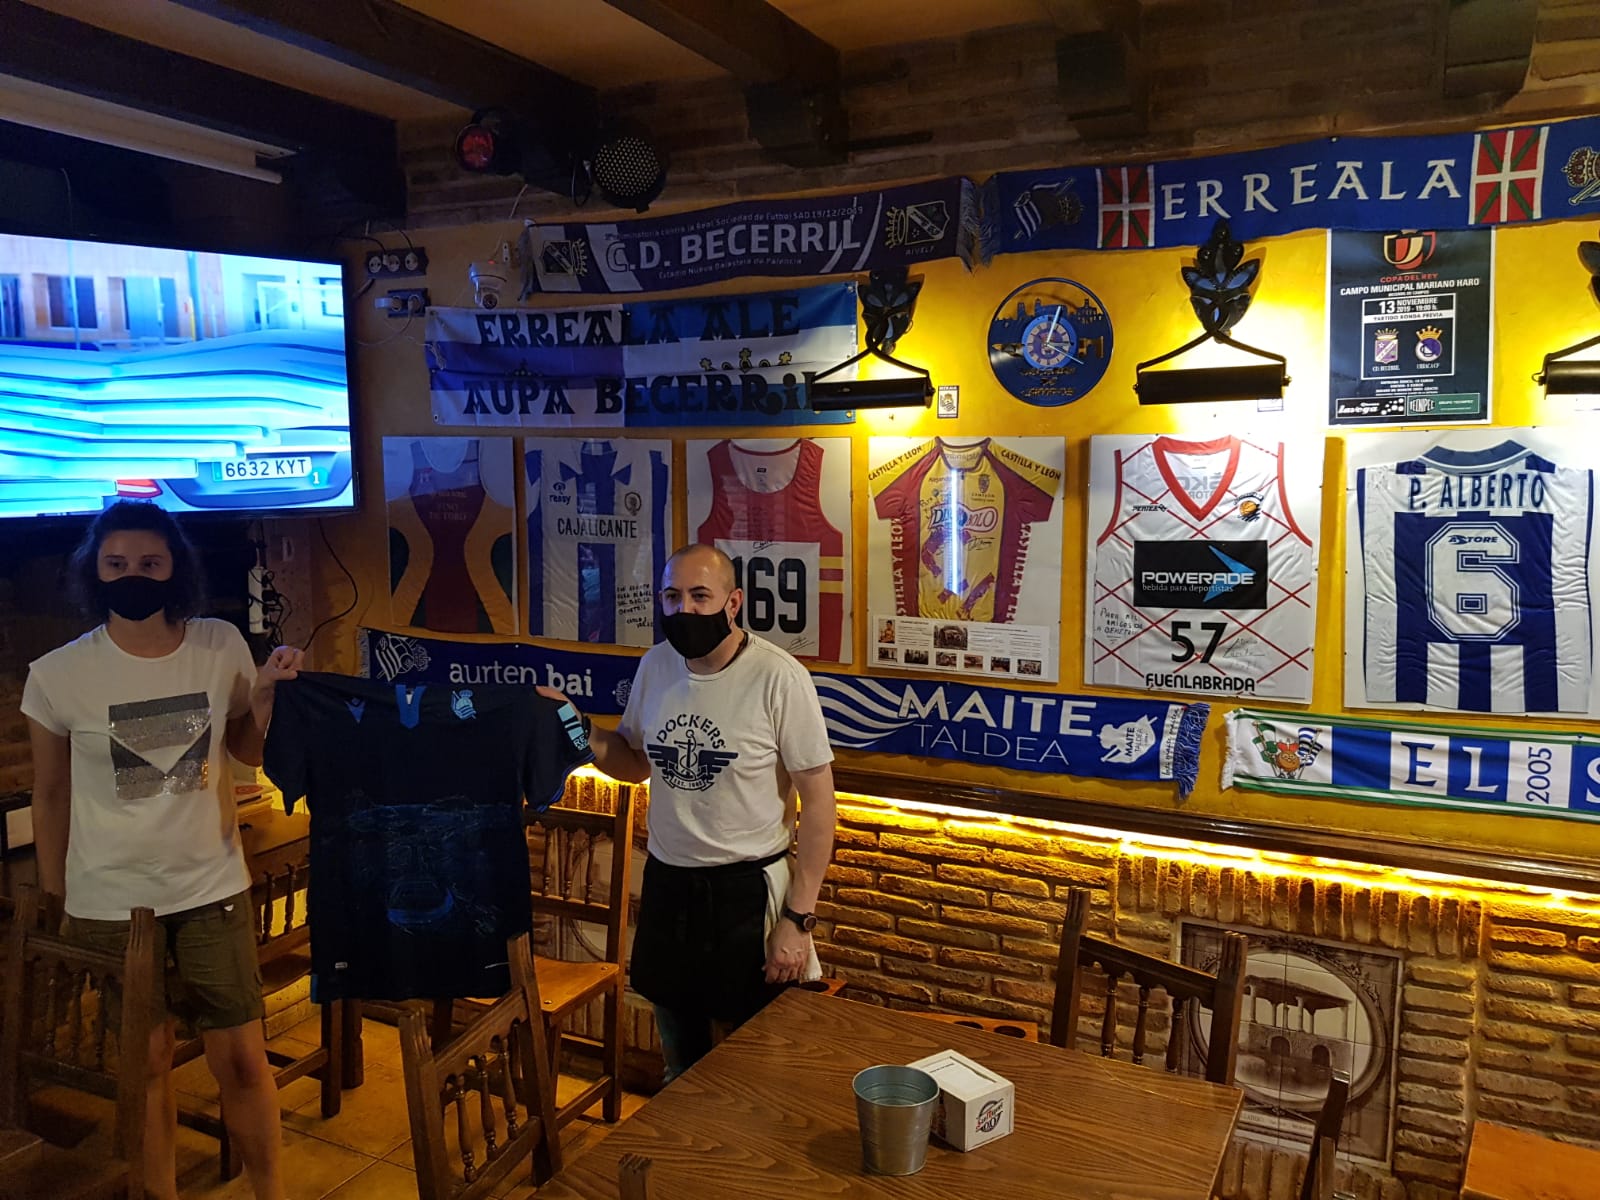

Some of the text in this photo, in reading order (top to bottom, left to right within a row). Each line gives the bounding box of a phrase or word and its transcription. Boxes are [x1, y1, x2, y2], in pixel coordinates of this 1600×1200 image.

[1161, 159, 1462, 221] ERREALA
[606, 217, 861, 273] C.D. BECERRIL
[1340, 277, 1480, 296] CAMPO MUNICIPAL MARIANO HARO
[1380, 275, 1404, 284] COPA
[1379, 300, 1396, 314] 13
[1397, 297, 1438, 307] NOVIEMBRE
[463, 378, 575, 416] AUPA
[225, 458, 307, 477] 6632 KYT
[868, 457, 899, 480] CASTILLA
[1001, 449, 1034, 470] CASTILLA
[1034, 463, 1041, 472] Y
[1410, 472, 1545, 510] P. ALBERTO
[557, 516, 638, 540] CAJALICANTE
[1142, 571, 1254, 585] POWERADE
[1142, 584, 1233, 594] bebida para deportistas
[1425, 521, 1520, 642] 6
[731, 555, 807, 635] 169
[1170, 621, 1228, 664] 57
[449, 661, 594, 698] aurten bai
[1145, 673, 1256, 692] FUENLABRADA
[899, 684, 1097, 737] MAITE
[656, 714, 725, 749] DOCKERS
[912, 723, 1070, 766] TALDEA
[1125, 727, 1135, 757] MAITE
[1526, 746, 1553, 805] 2005
